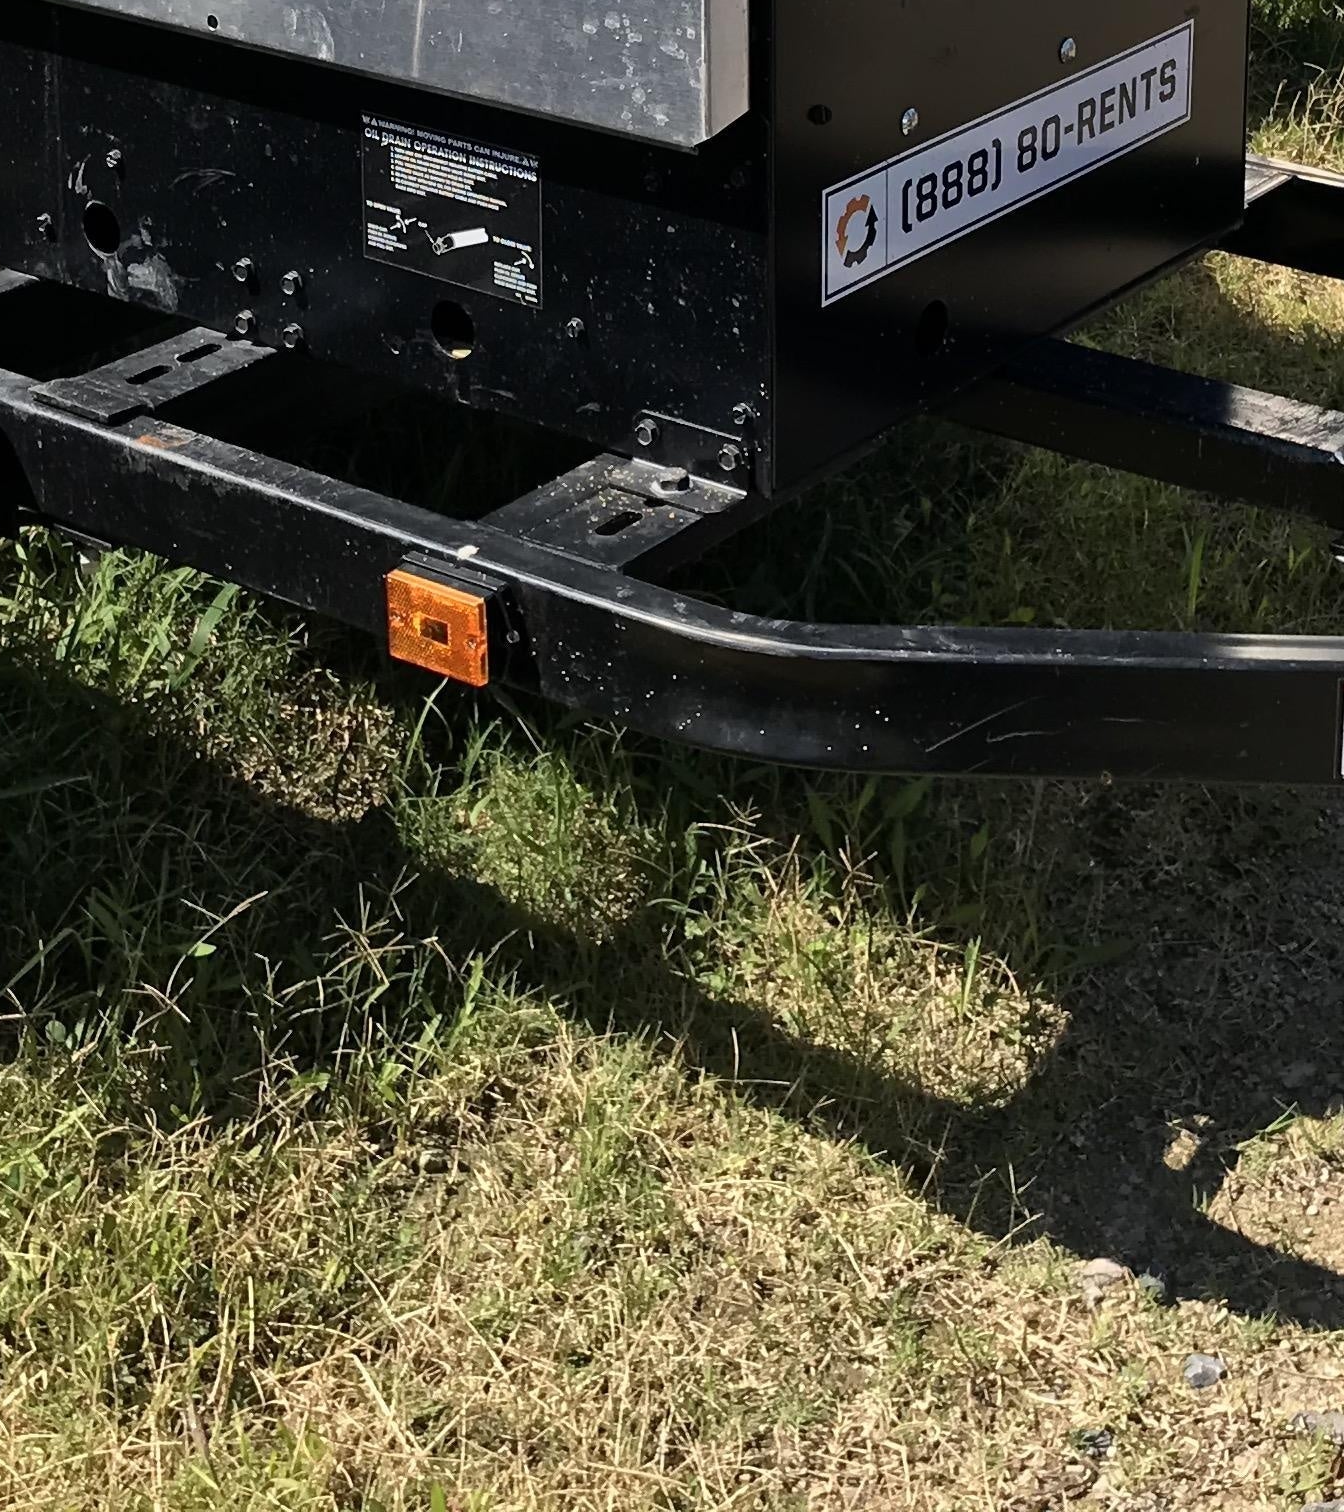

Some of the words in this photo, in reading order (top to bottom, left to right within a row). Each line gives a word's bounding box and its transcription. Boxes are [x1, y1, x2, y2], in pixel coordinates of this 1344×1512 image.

[364, 127, 380, 141] OIL
[381, 131, 411, 149] DRAIN
[413, 140, 467, 163] OPERATION
[469, 155, 538, 183] INSTRUCTIONS
[901, 137, 1002, 234] (888)
[1017, 58, 1177, 174] 80-RENTS
